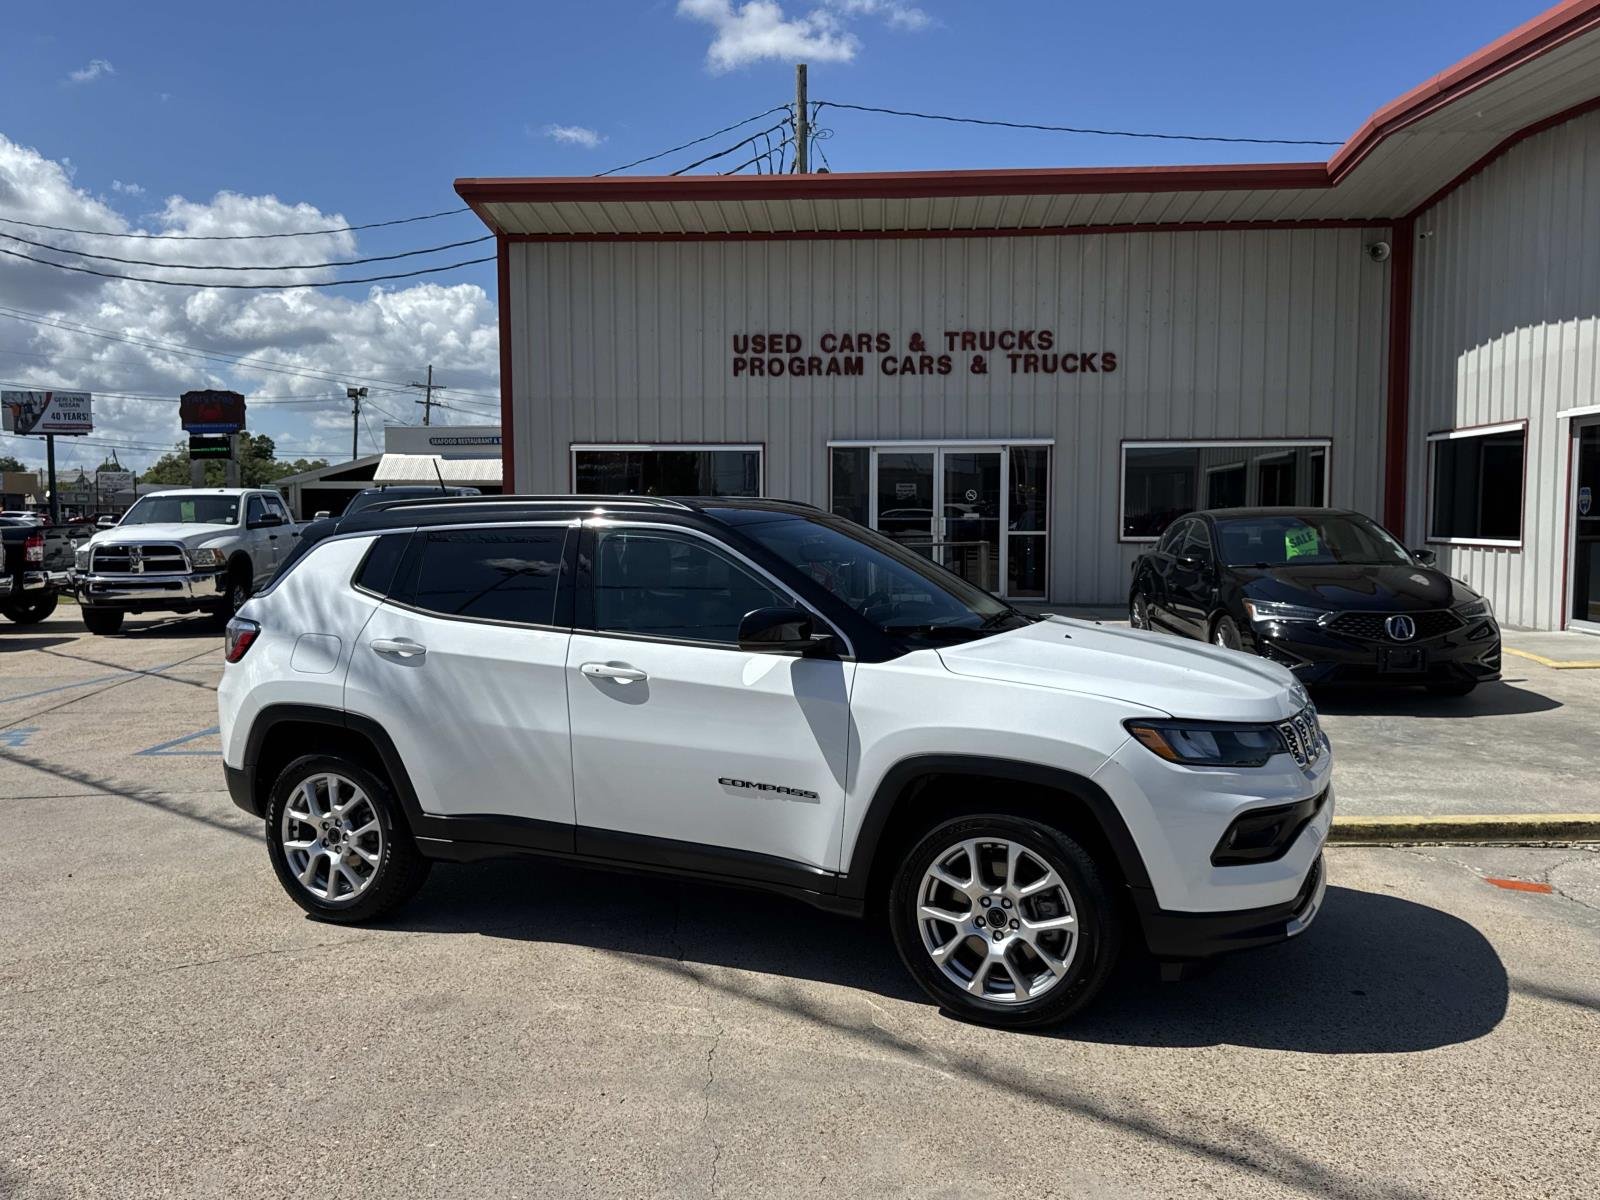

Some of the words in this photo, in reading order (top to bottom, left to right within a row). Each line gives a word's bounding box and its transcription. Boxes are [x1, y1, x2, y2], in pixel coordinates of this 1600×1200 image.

[732, 333, 802, 354] USED
[820, 332, 891, 353] CARS
[908, 332, 926, 352] &
[944, 330, 1054, 351] TRUCKS
[732, 356, 865, 377] PROGRAM
[881, 355, 953, 376] CARS
[970, 355, 988, 374] &
[1006, 352, 1118, 374] TRUCKS
[51, 412, 61, 421] 40
[63, 412, 89, 421] YEARS!
[1289, 531, 1314, 549] SALE
[718, 777, 818, 799] COMPASS
